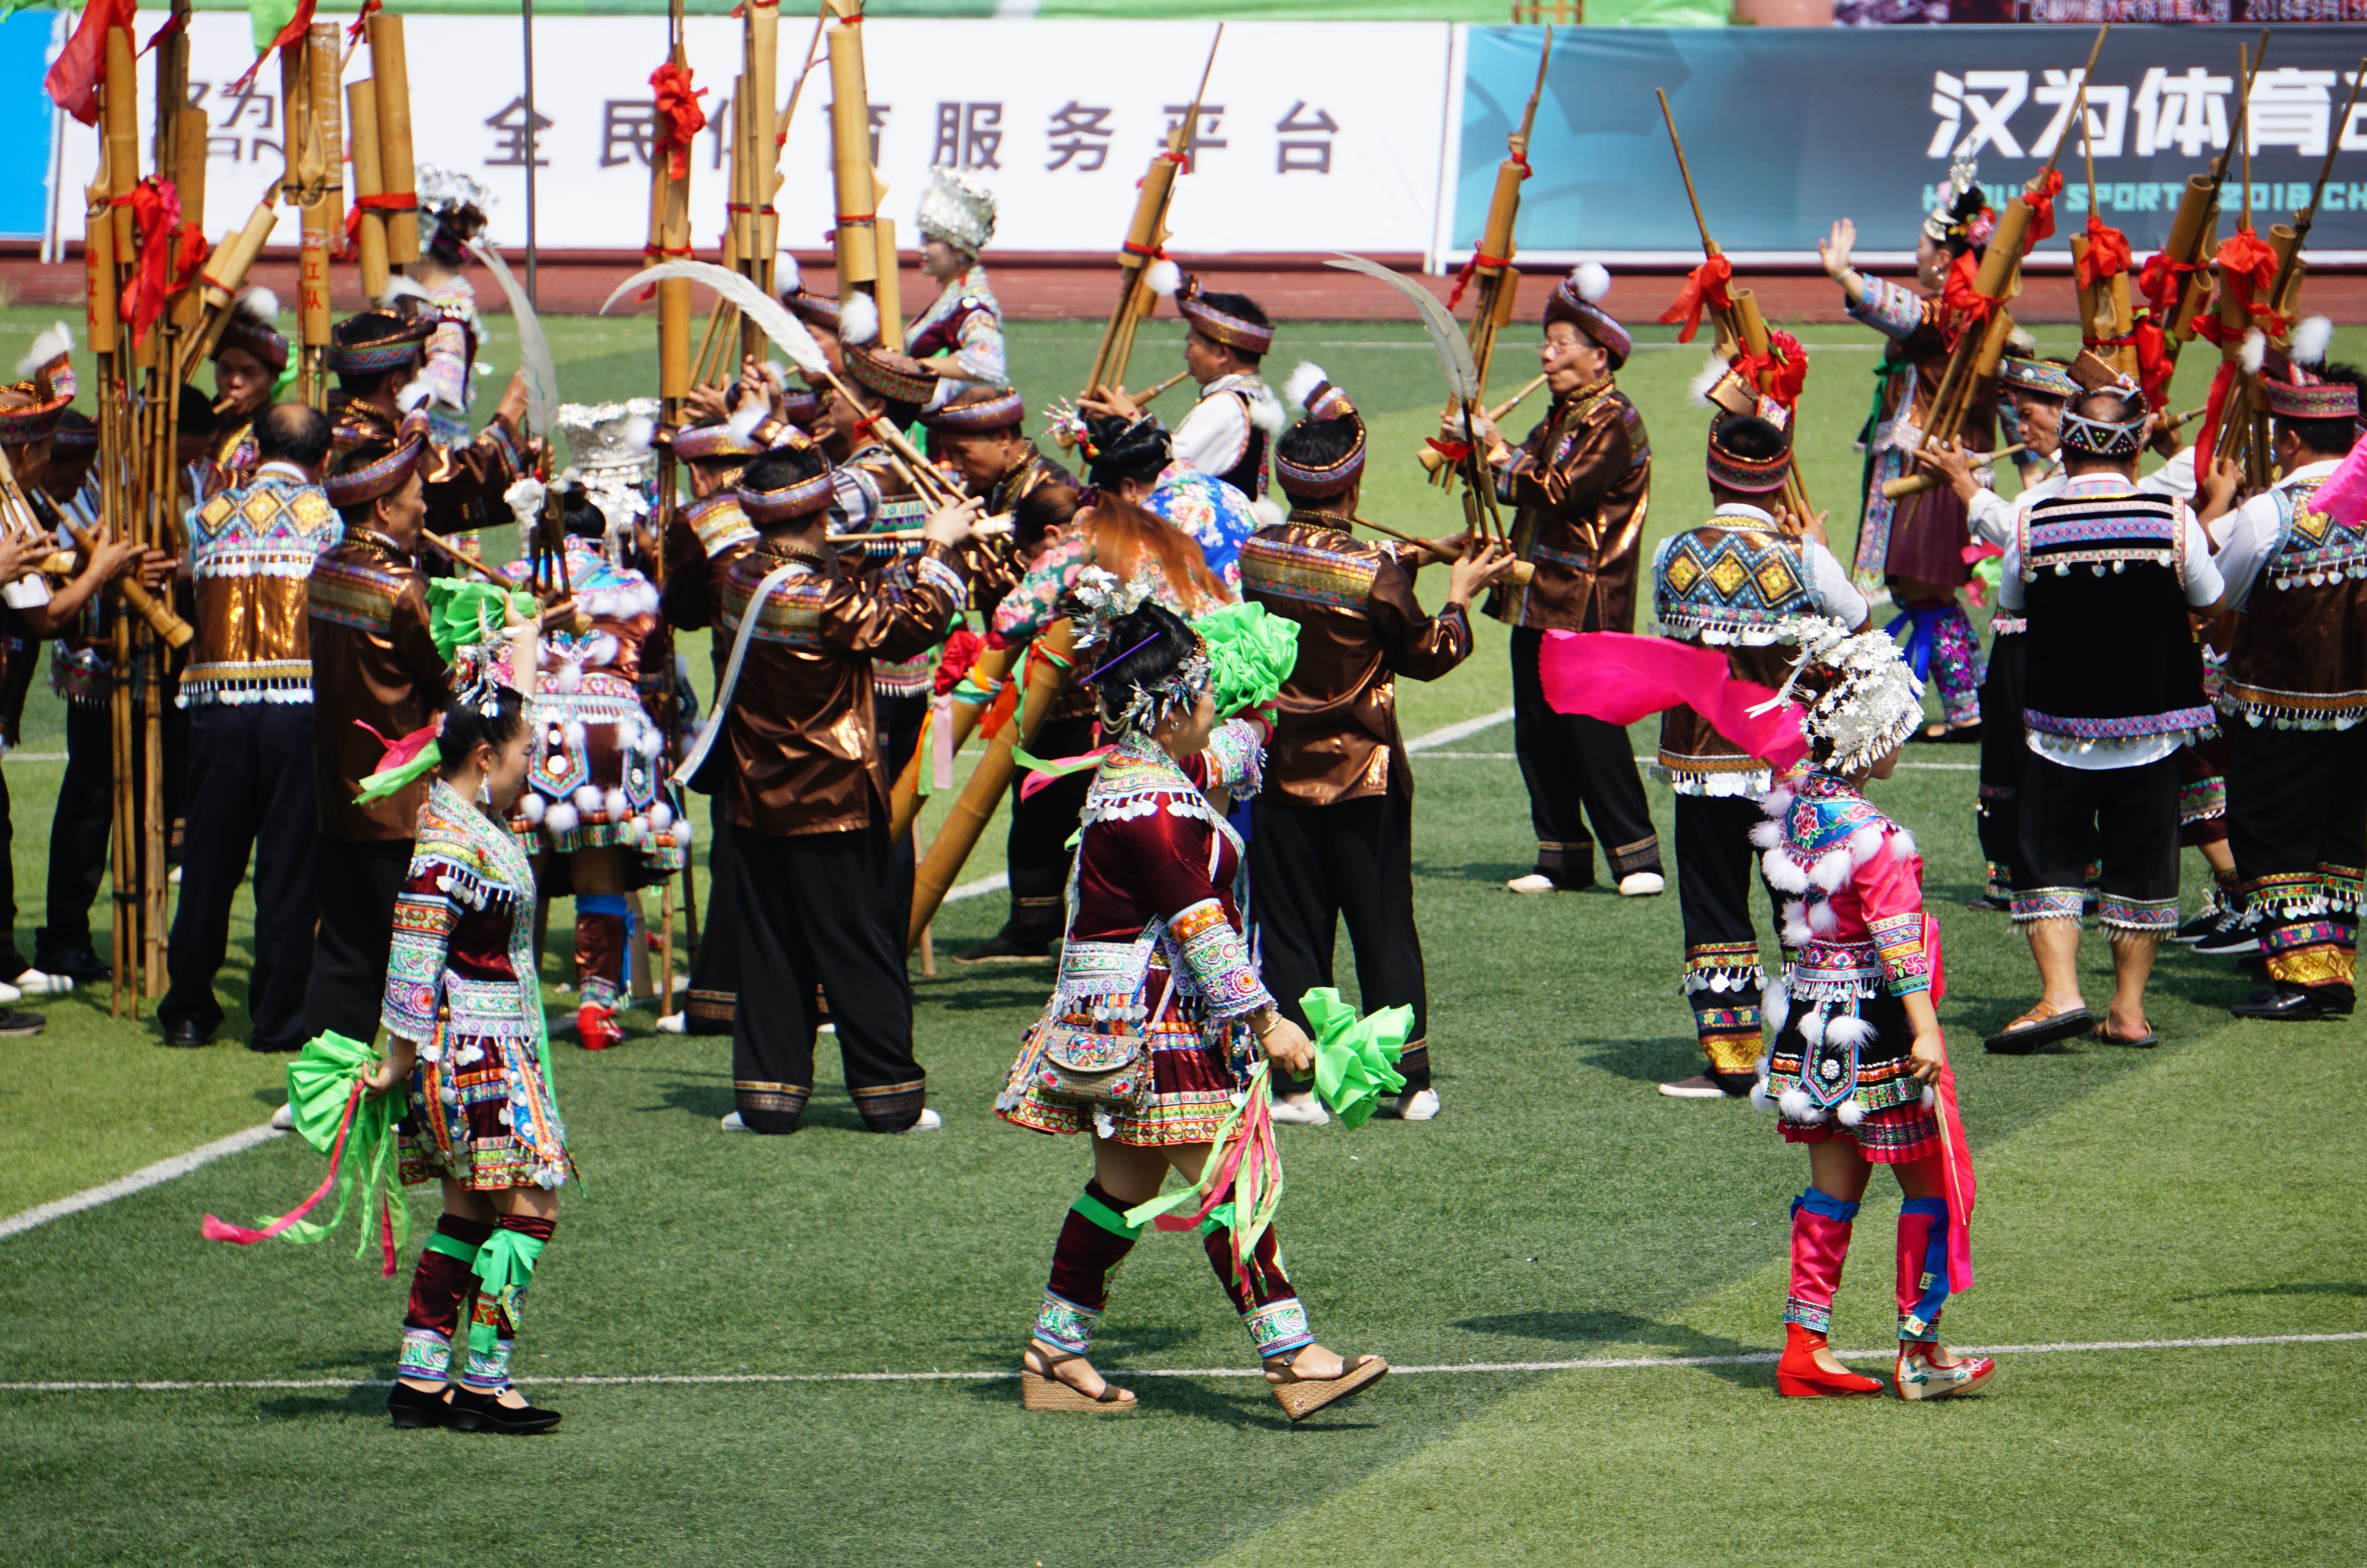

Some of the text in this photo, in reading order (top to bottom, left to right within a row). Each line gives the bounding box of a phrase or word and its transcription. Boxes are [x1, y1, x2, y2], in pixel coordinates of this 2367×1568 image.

[2245, 0, 2367, 21] 2018年9月15
[154, 80, 274, 127] 为
[2219, 182, 2312, 211] 2018
[2322, 182, 2367, 211] CH
